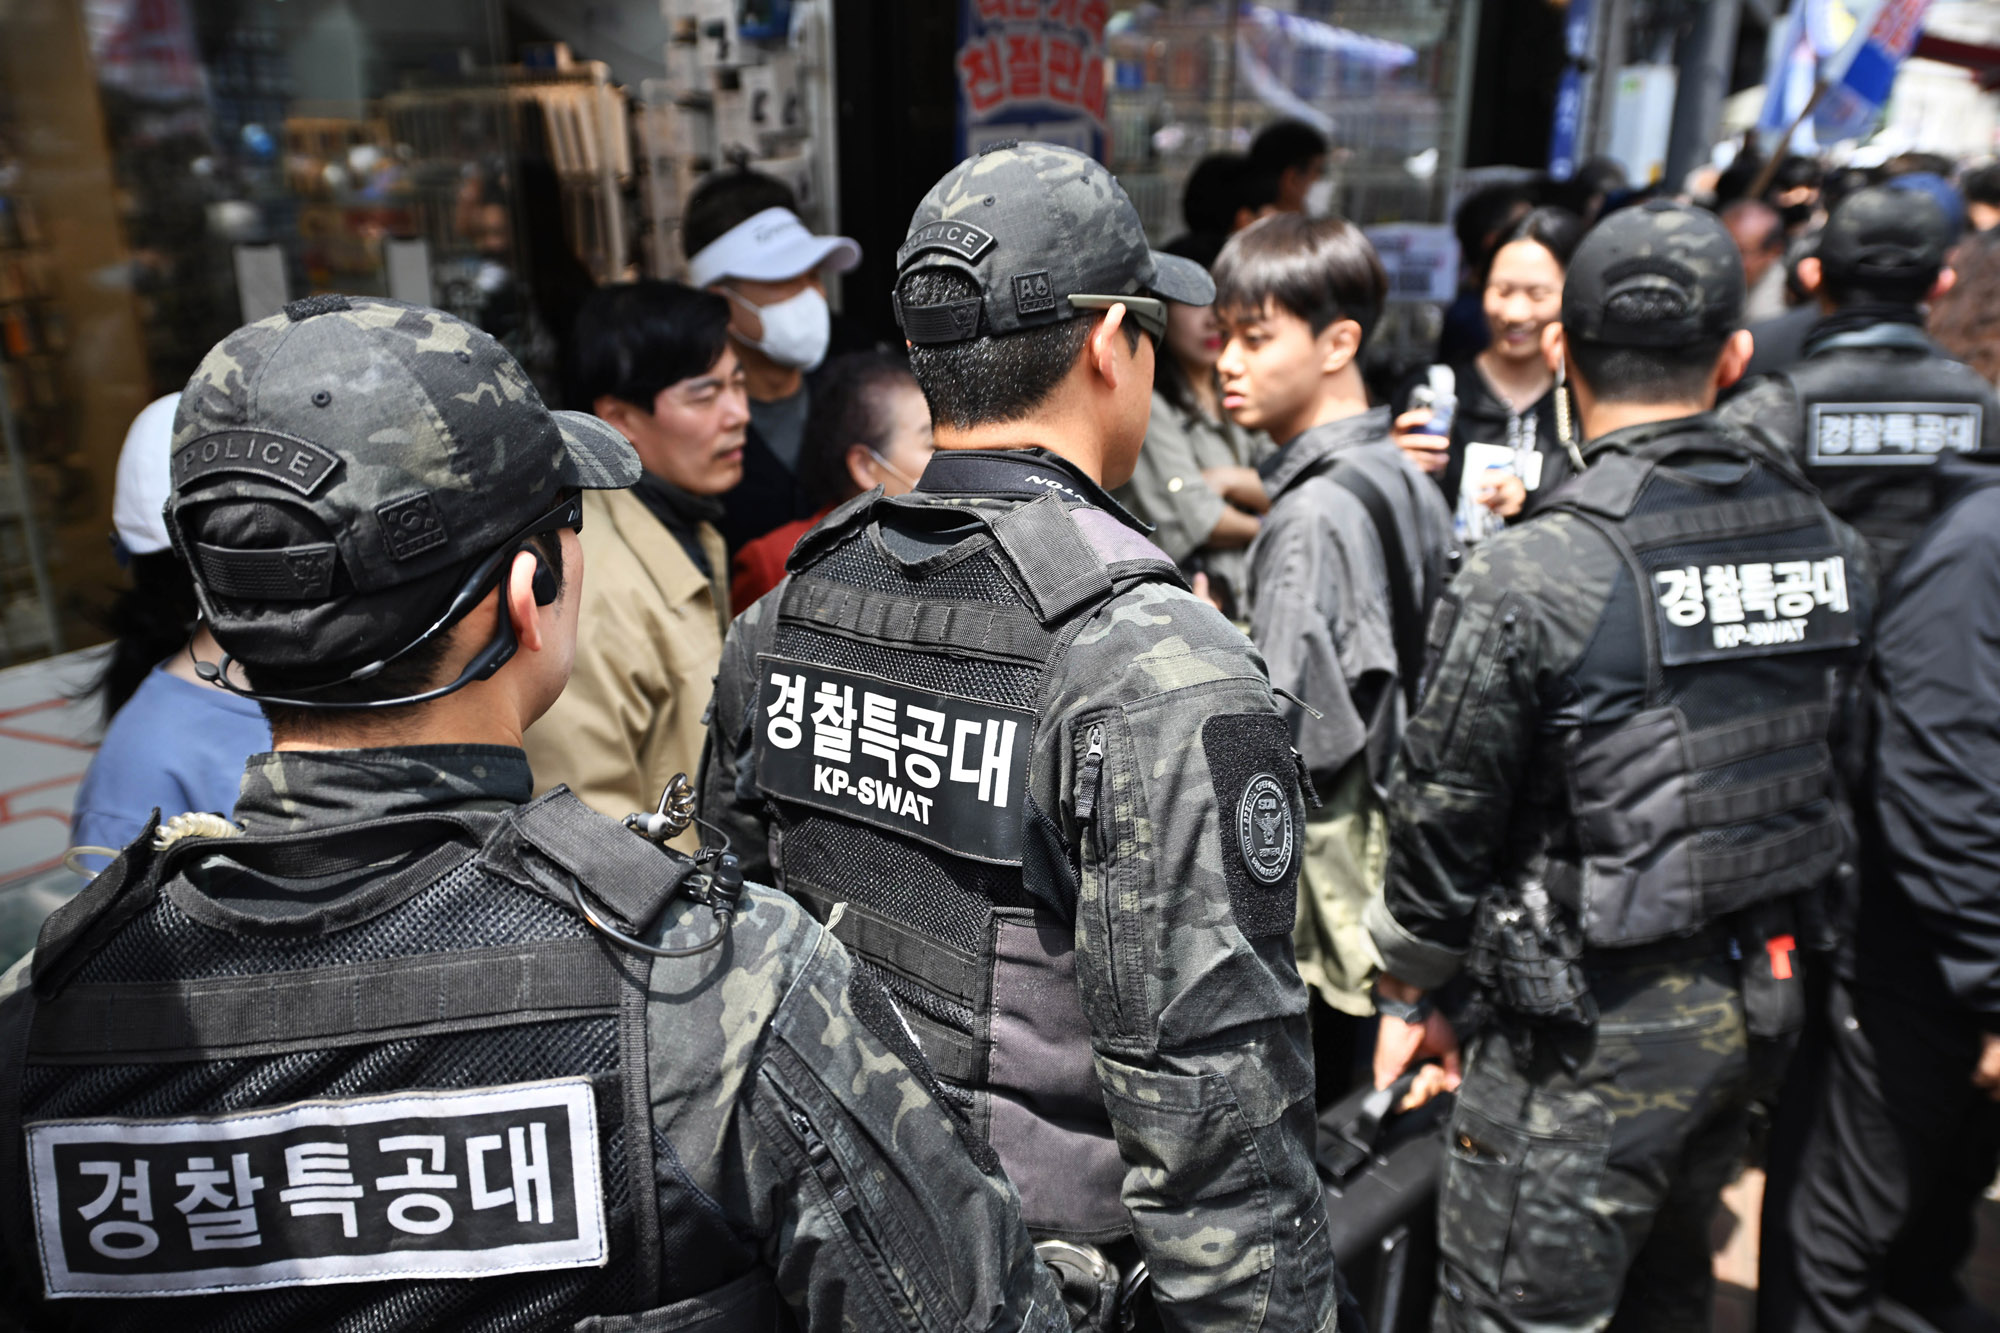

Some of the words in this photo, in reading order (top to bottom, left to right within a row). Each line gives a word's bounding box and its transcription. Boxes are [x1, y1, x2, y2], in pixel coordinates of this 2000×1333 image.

[901, 226, 979, 260] POLICE
[182, 438, 314, 478] POLICE
[1820, 413, 1976, 455] 경찰특공대
[1655, 556, 1849, 627] 경찰특공대
[1713, 618, 1809, 649] KP-SWAT
[766, 672, 1018, 808] 경찰특공대
[813, 764, 934, 826] KP-SWAT
[78, 1122, 554, 1260] 경찰특공대
